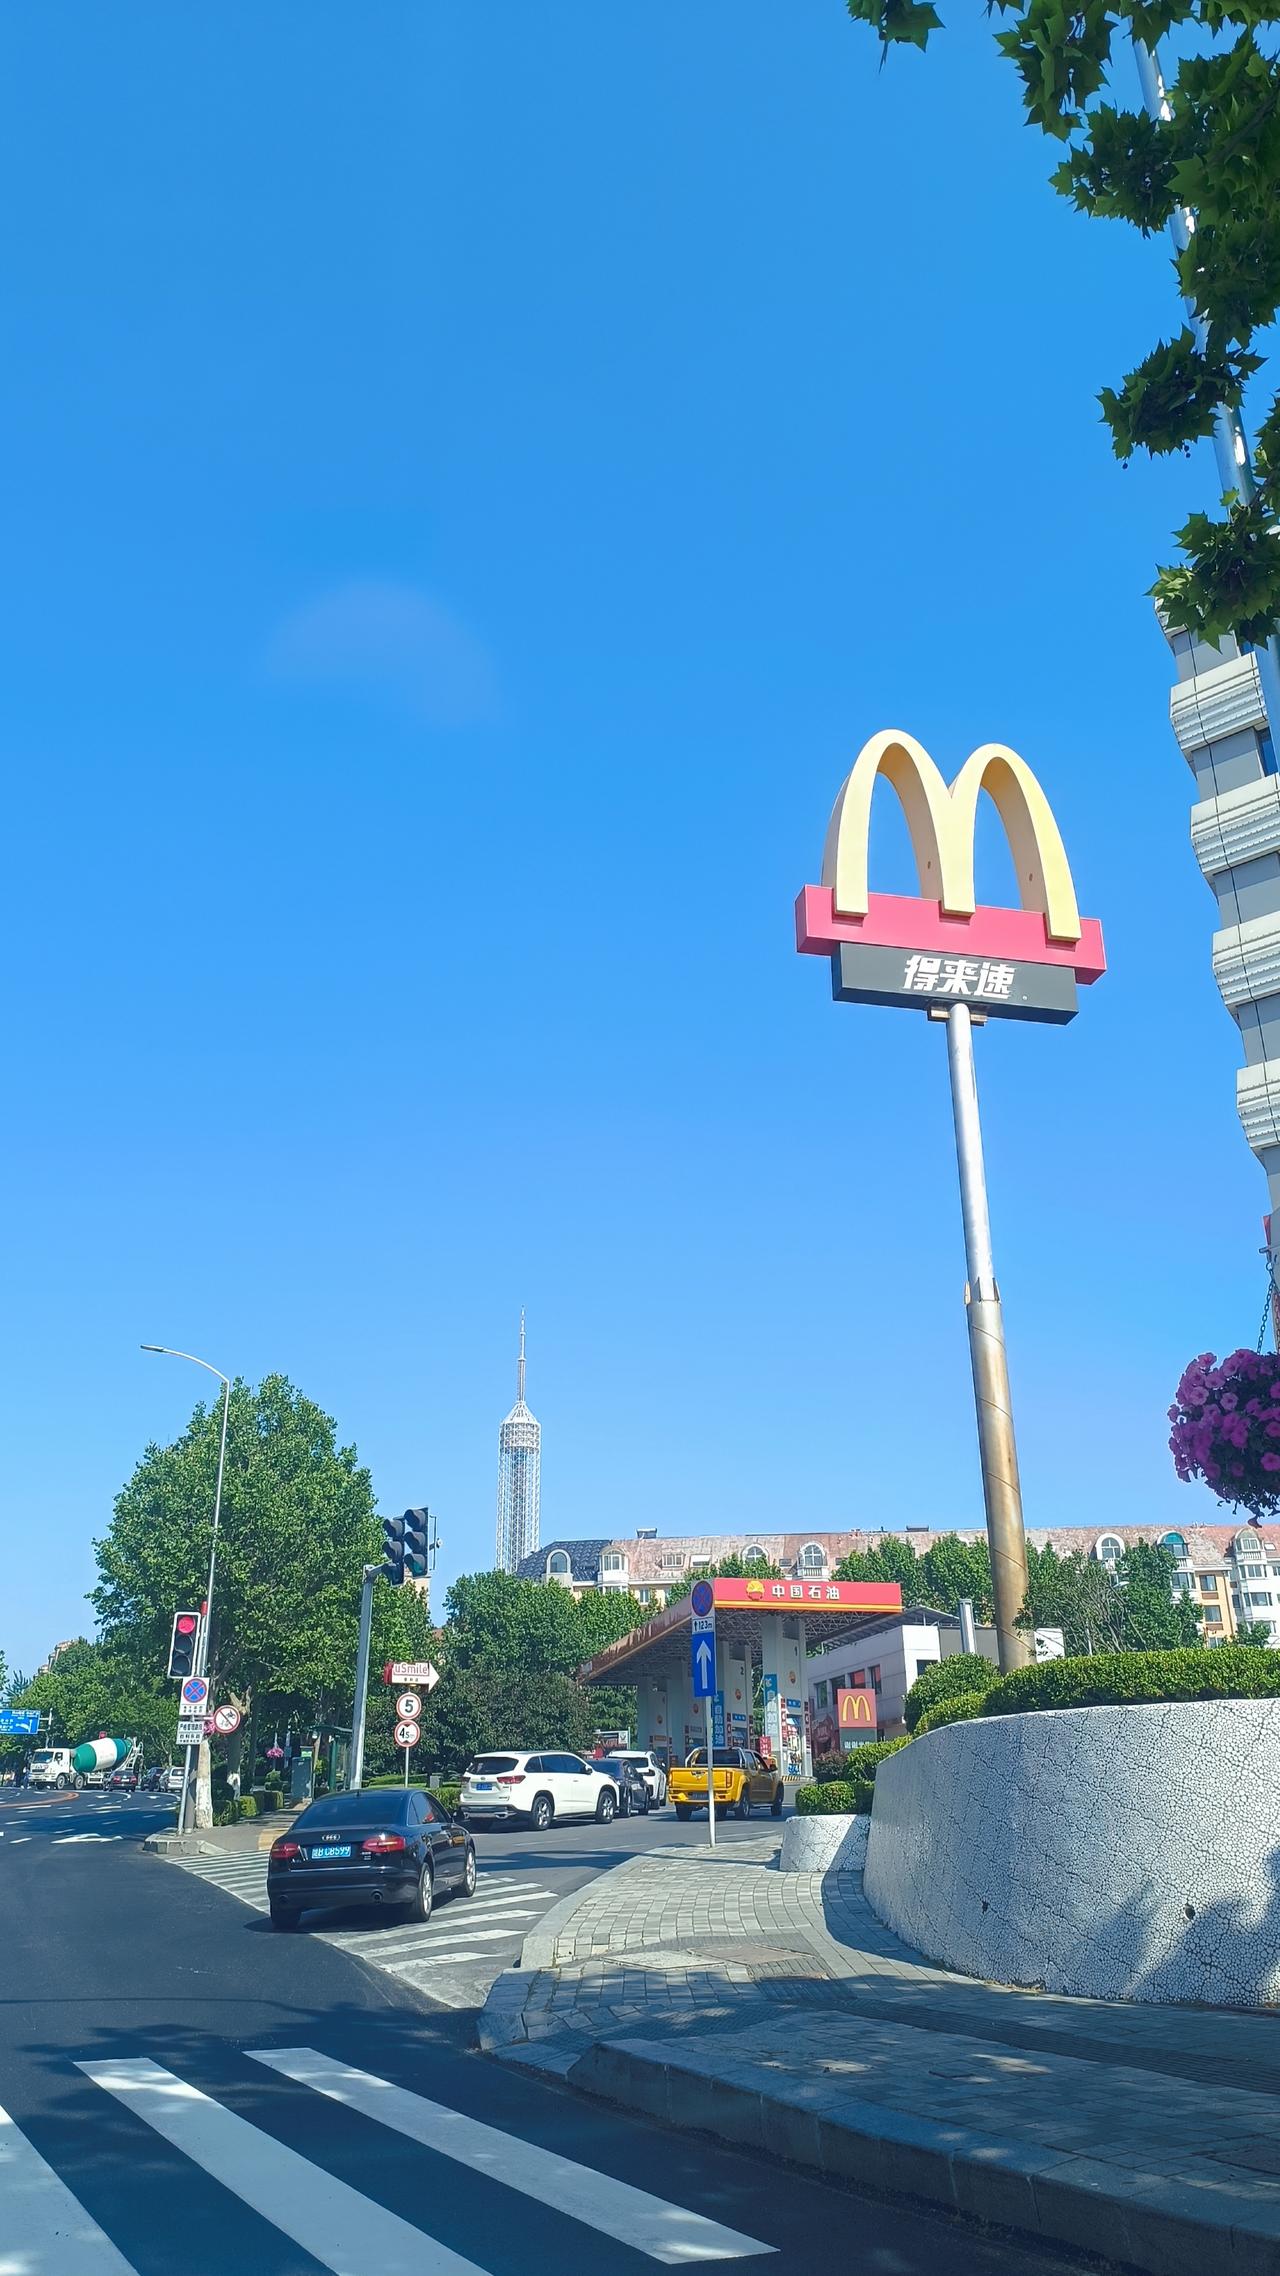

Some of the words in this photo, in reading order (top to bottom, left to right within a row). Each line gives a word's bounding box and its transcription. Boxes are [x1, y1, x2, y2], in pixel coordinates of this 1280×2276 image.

[902, 954, 1016, 1000] 得来速
[771, 1584, 840, 1600] 中国石油
[394, 1663, 428, 1674] uSmile
[404, 1699, 414, 1713] 5
